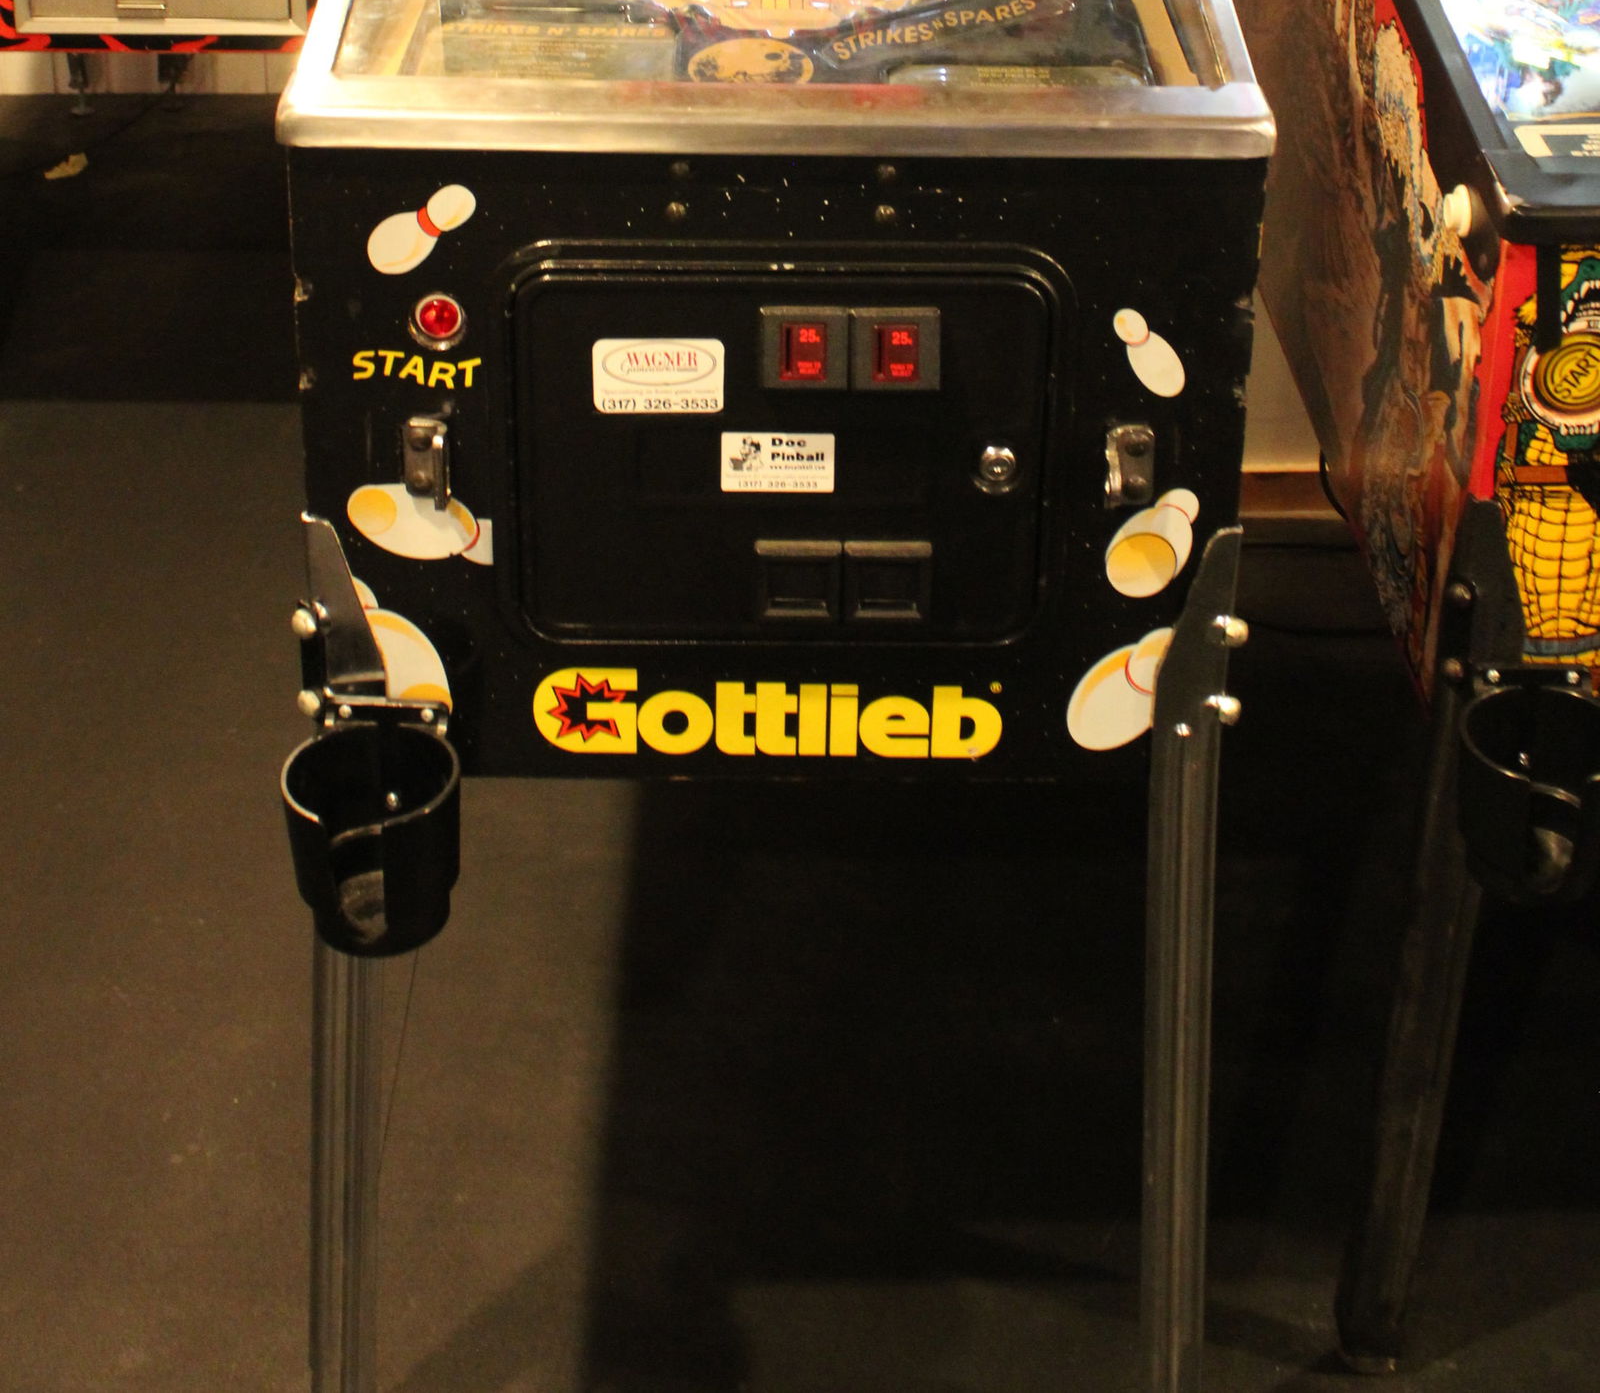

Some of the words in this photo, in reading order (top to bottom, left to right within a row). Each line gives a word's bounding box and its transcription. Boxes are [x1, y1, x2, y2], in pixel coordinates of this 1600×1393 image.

[442, 21, 542, 36] STRIKES
[576, 26, 668, 38] SPARES
[832, 21, 934, 60] STRIKES
[626, 351, 698, 367] WAGNER
[352, 349, 482, 389] START
[1553, 348, 1600, 399] START
[602, 397, 637, 411] (317)
[643, 397, 719, 410] 326-3533
[771, 437, 807, 447] Doc
[770, 451, 825, 462] Pinball
